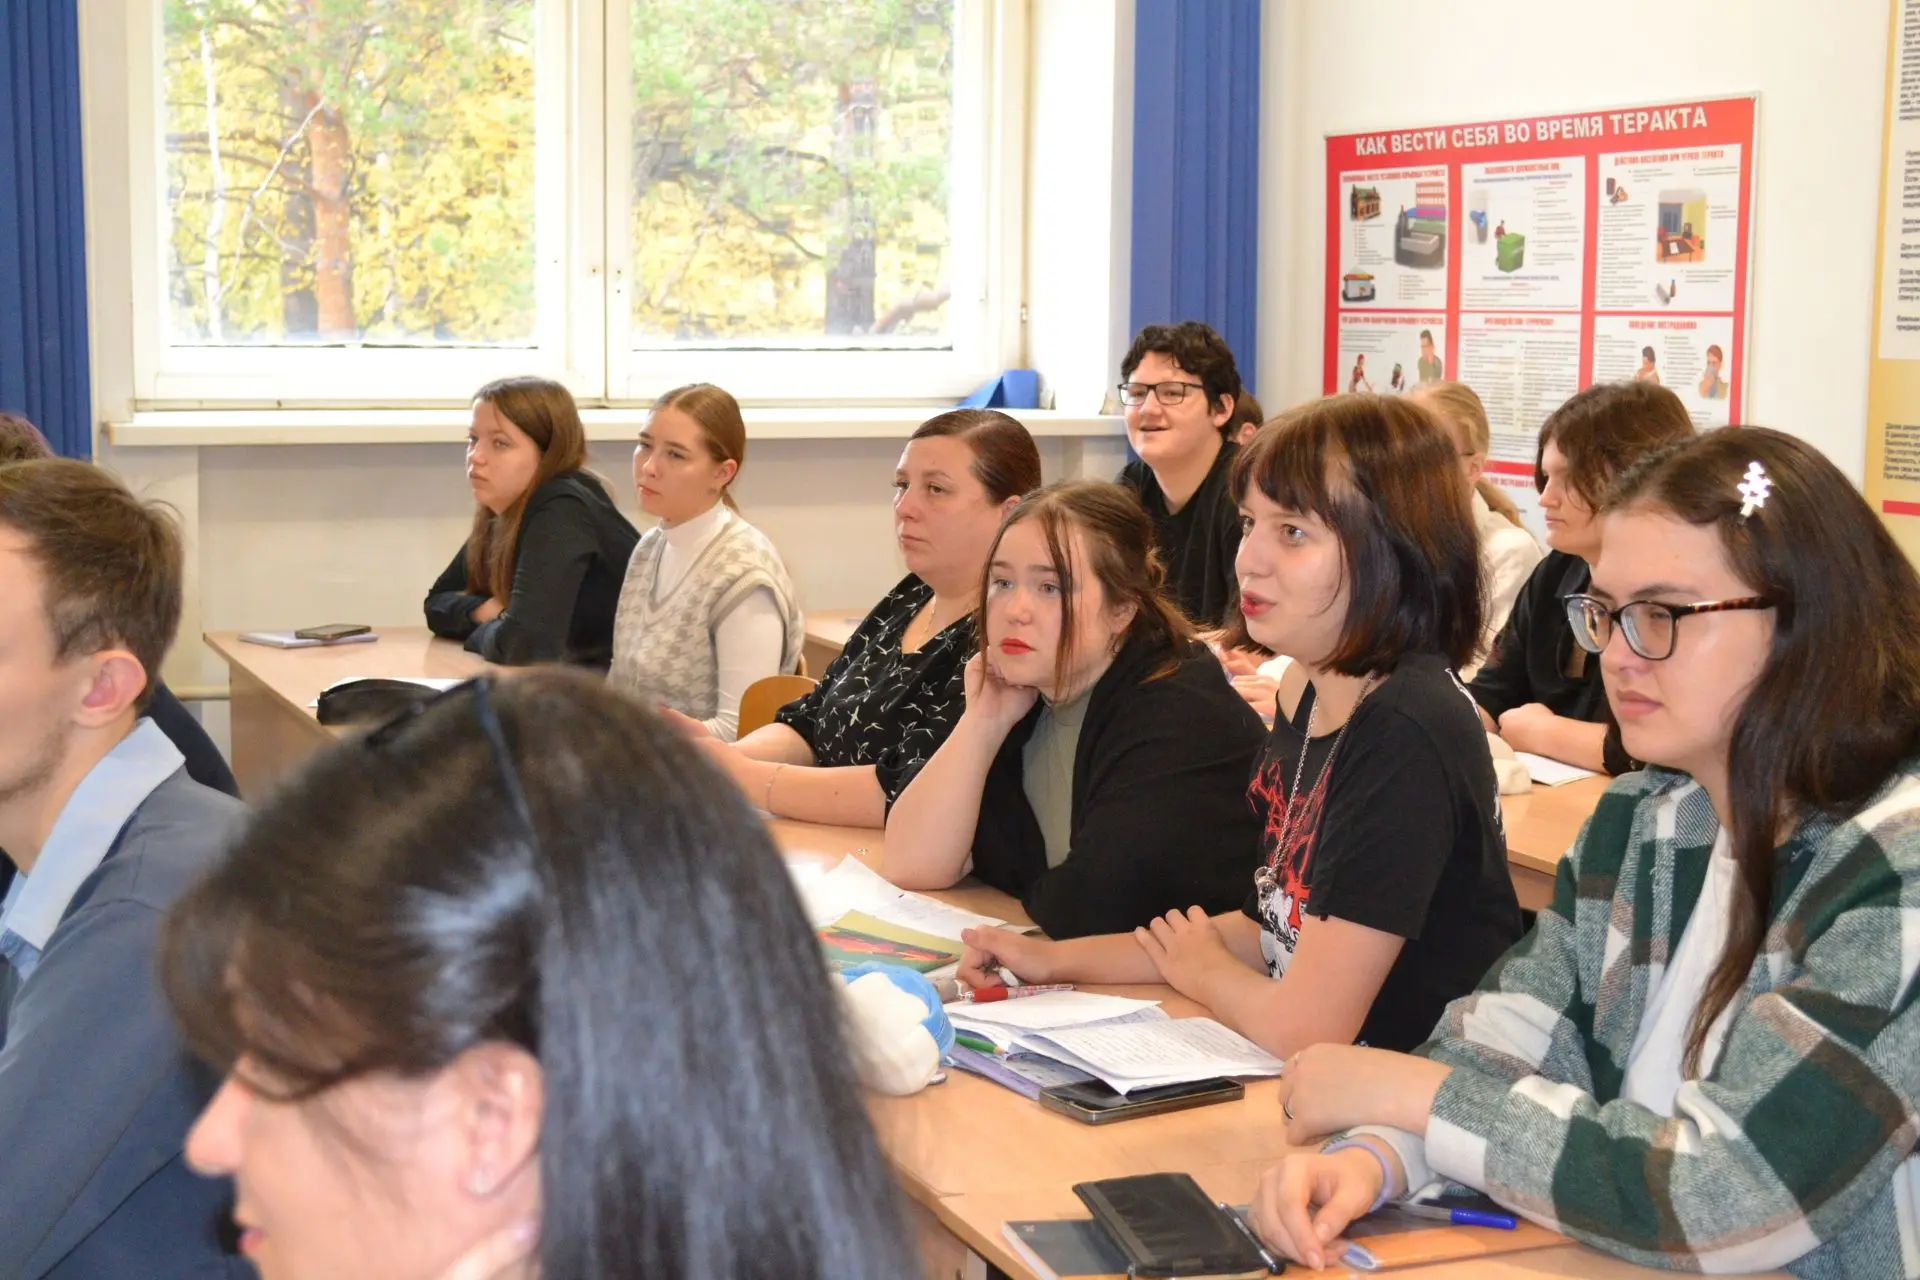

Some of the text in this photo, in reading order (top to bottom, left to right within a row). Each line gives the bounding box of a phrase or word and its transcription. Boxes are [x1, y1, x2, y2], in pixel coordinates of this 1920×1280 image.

[1356, 105, 1708, 156] КАК ВЕСТИ СЕБЯ ВО ВРЕМЯ ТЕРАКТА
